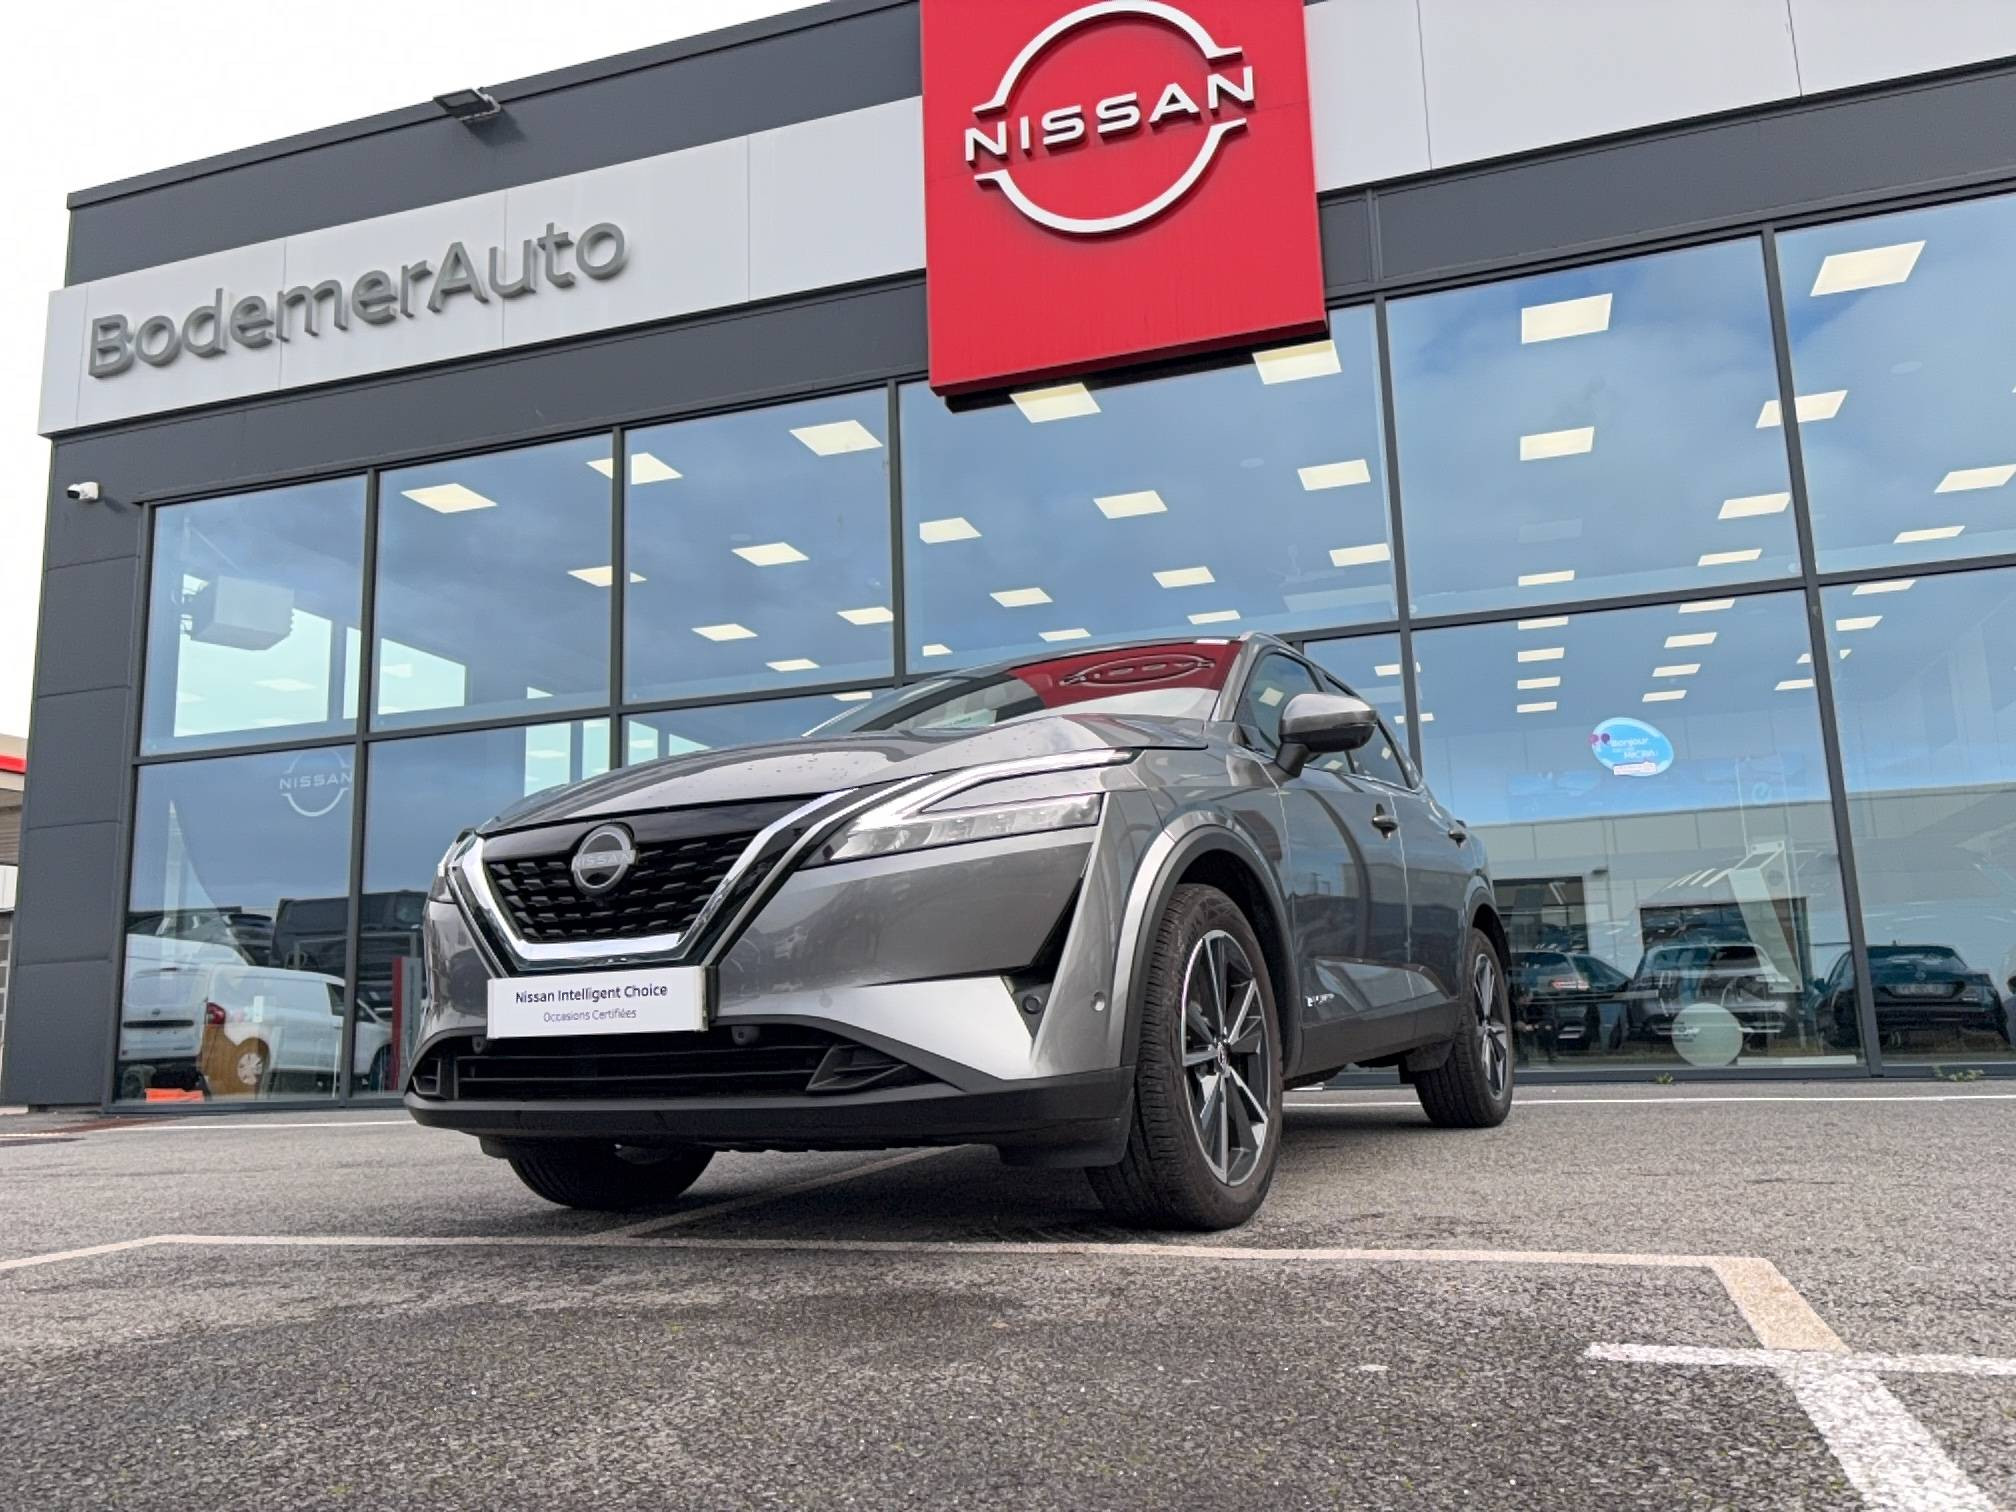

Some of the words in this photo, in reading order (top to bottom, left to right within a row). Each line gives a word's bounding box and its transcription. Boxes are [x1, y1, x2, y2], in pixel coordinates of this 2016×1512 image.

[964, 66, 1255, 167] NISSAN
[88, 222, 628, 379] BodemerAuto
[279, 772, 353, 790] NISSAN
[515, 991, 555, 1004] Nissan
[558, 986, 622, 1003] Intelligent
[624, 984, 668, 998] Choice
[543, 1010, 591, 1023] Occasions
[592, 1008, 637, 1021] Certifiées
